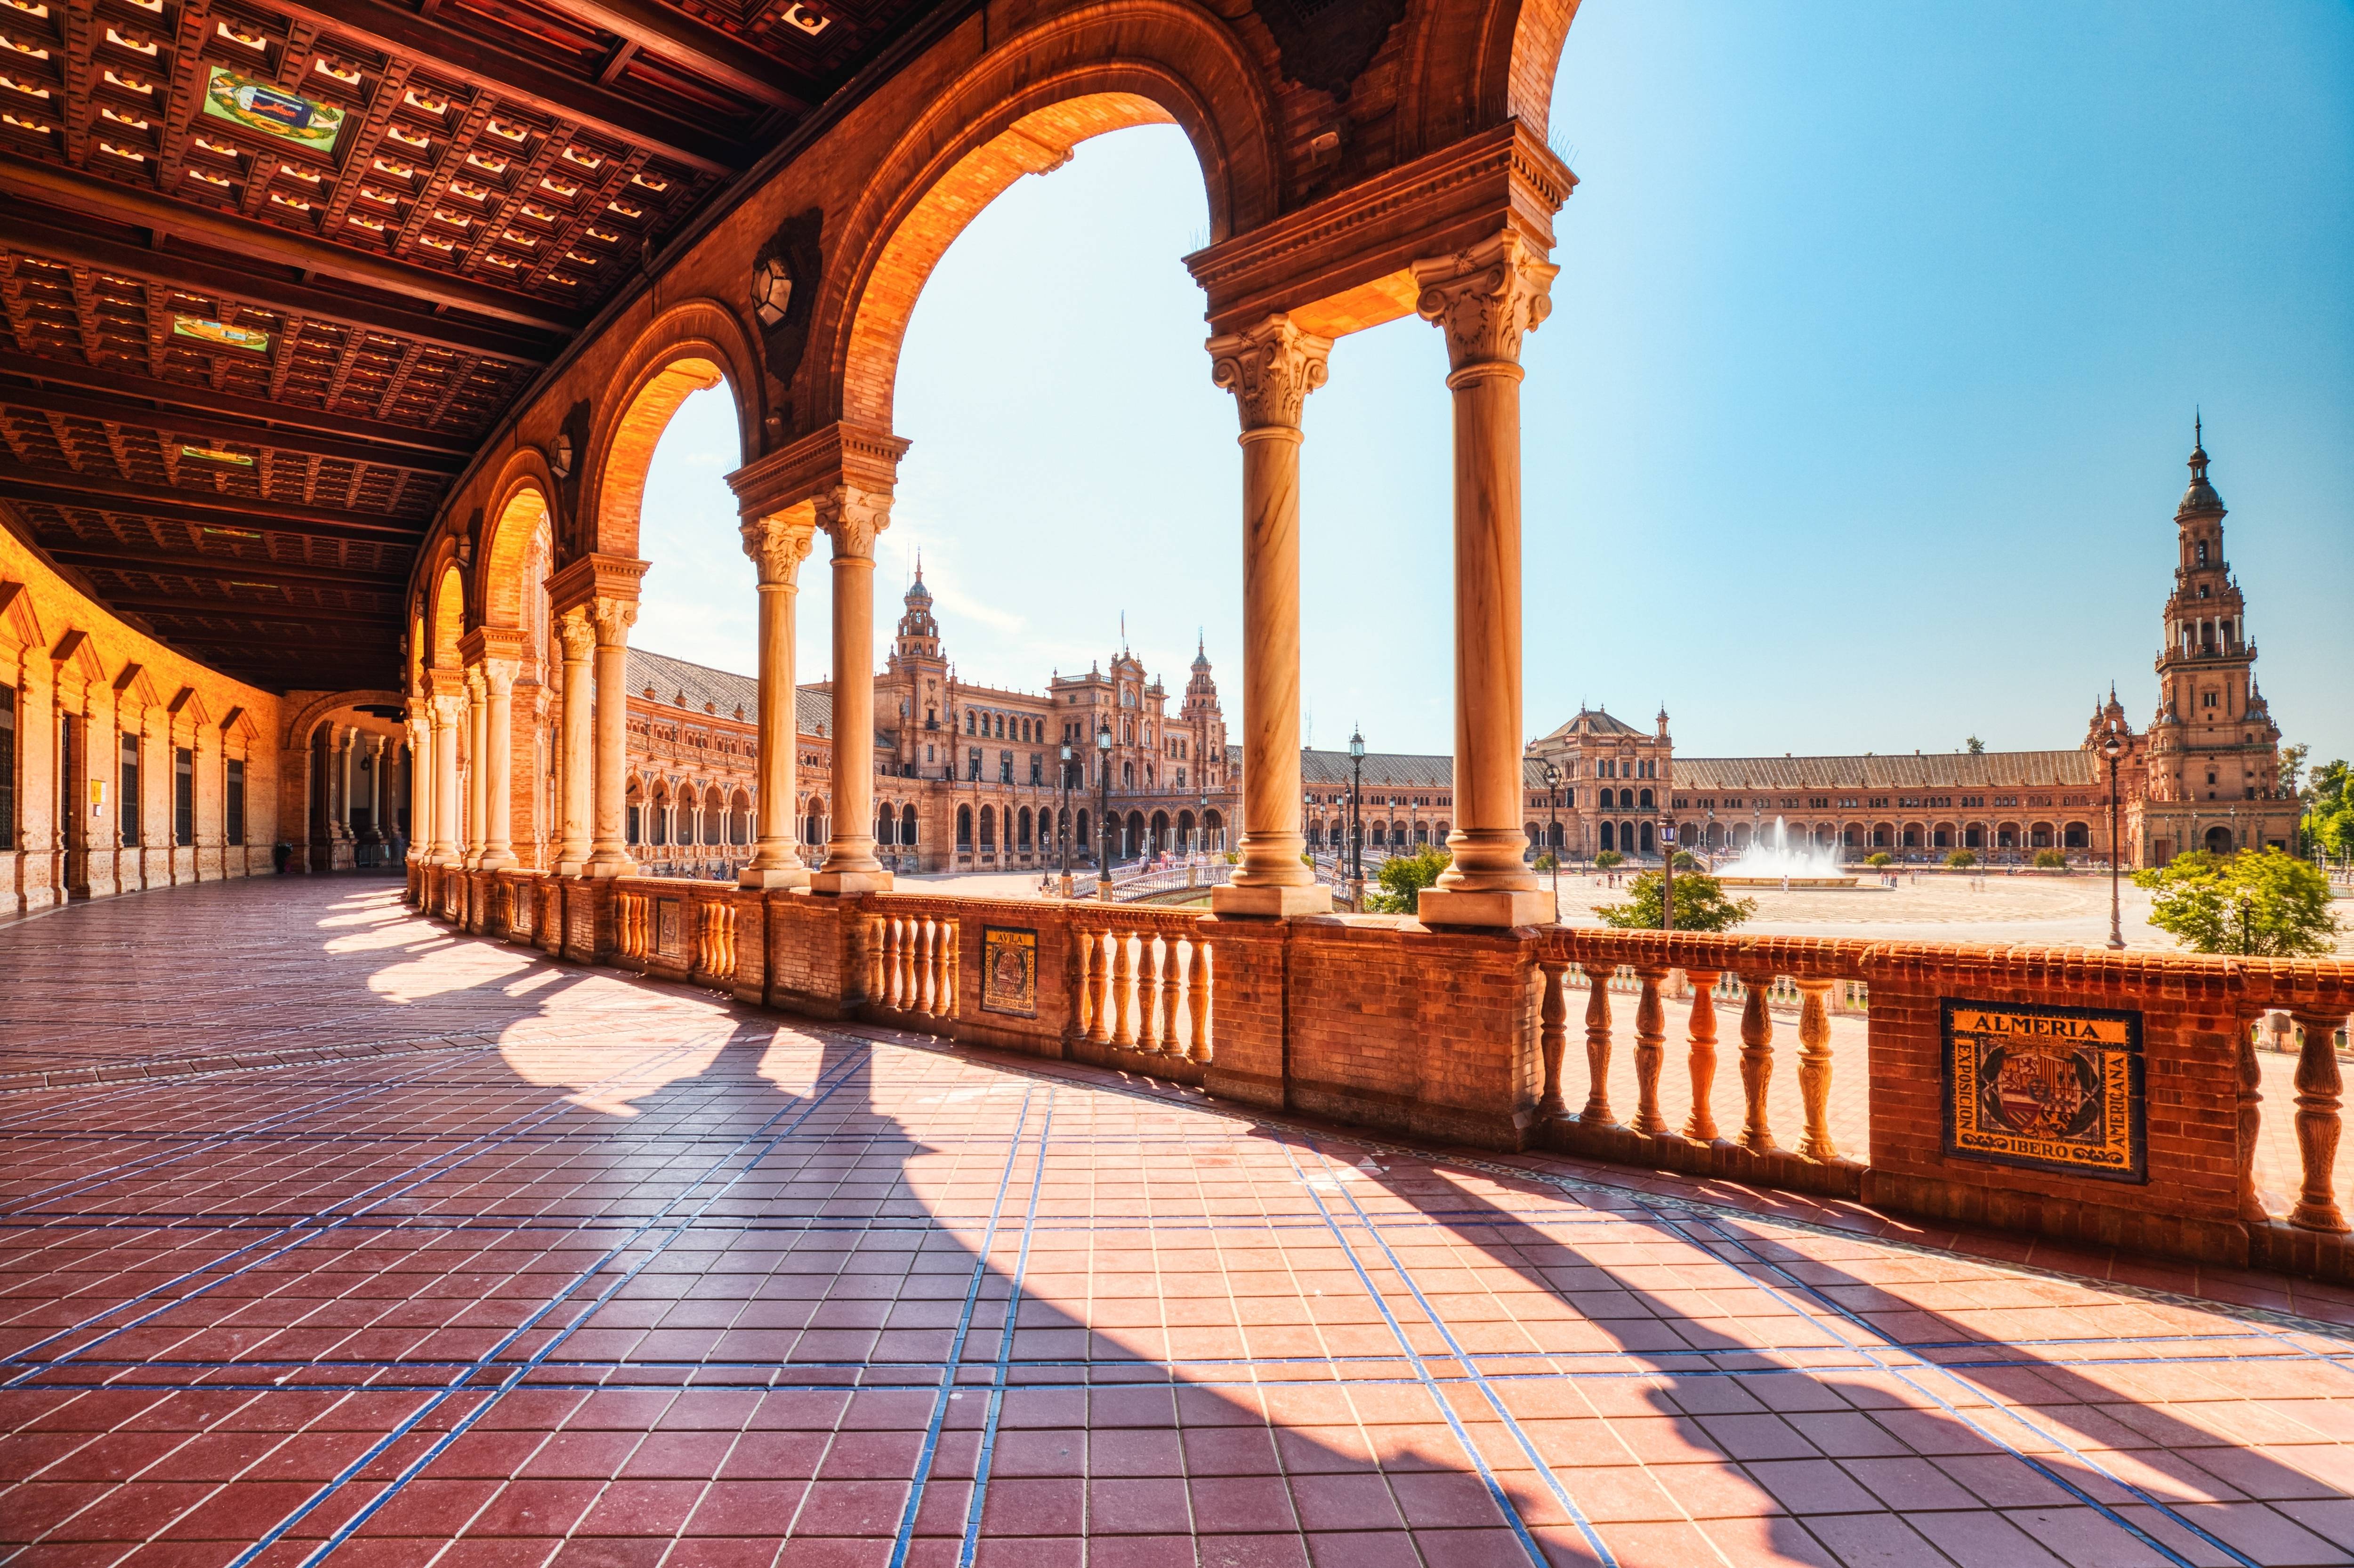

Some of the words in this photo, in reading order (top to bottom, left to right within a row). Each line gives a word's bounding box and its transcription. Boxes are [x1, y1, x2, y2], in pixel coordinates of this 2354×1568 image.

[998, 933, 1023, 944] AVILA
[1000, 998, 1017, 1008] IBERO
[1973, 1015, 2102, 1039] ALMERIA
[1958, 1044, 1973, 1130] EXPOSICION
[2109, 1057, 2125, 1149] AMERICANA
[2010, 1139, 2069, 1158] IBERO
